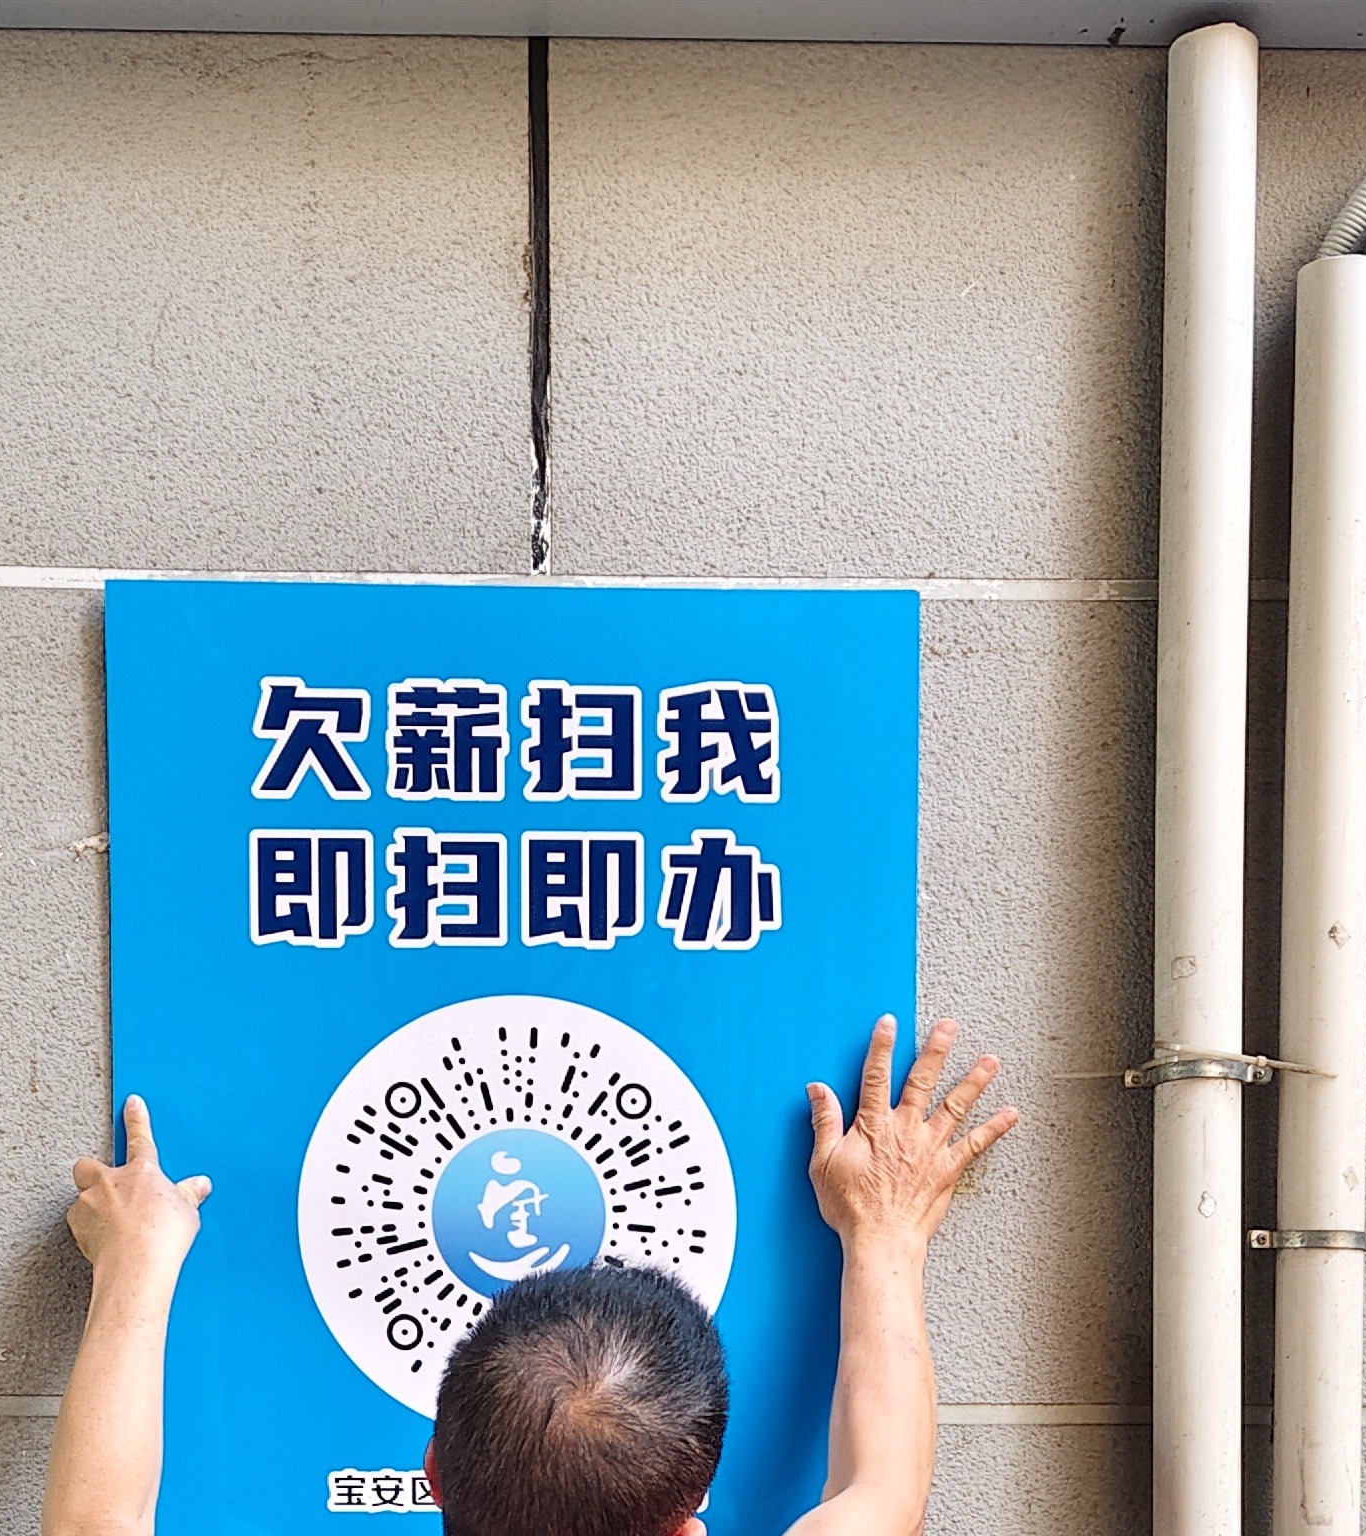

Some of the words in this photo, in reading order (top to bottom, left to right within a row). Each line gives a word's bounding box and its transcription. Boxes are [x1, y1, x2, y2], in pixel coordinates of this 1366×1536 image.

[253, 677, 780, 803] 欠薪扫我
[250, 828, 782, 950] 即扫即办
